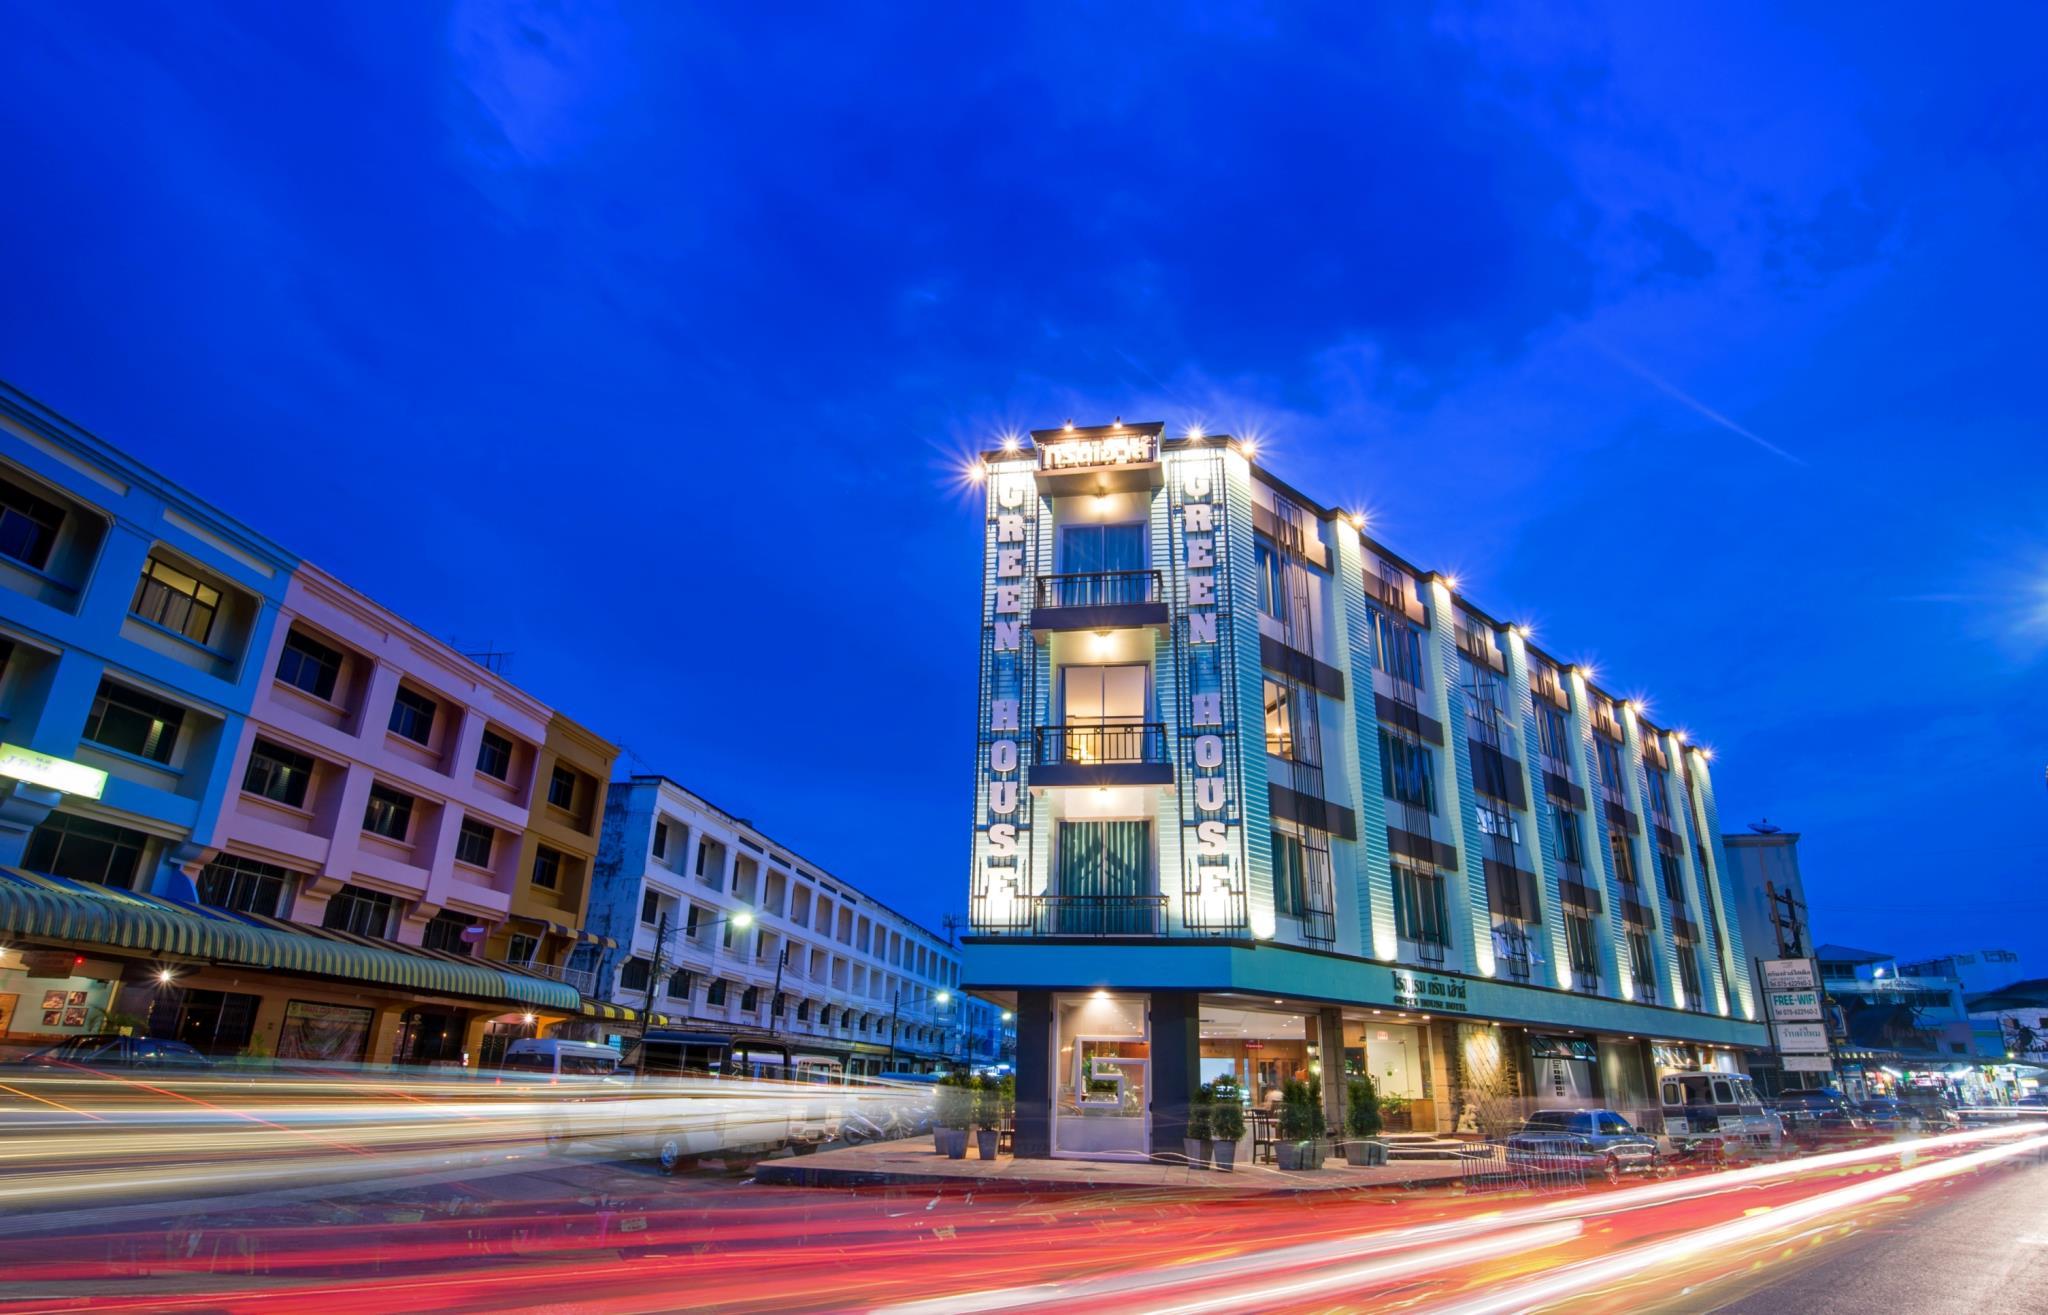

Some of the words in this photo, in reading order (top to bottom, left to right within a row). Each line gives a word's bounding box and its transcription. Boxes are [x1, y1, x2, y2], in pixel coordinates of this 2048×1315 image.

[994, 475, 1025, 651] GREEN
[1184, 465, 1217, 643] GREEN
[988, 699, 1021, 900] HOUSE
[1192, 693, 1230, 900] HOUSE
[1421, 999, 1443, 1009] HOUSE
[1446, 1002, 1467, 1011] HOTEL
